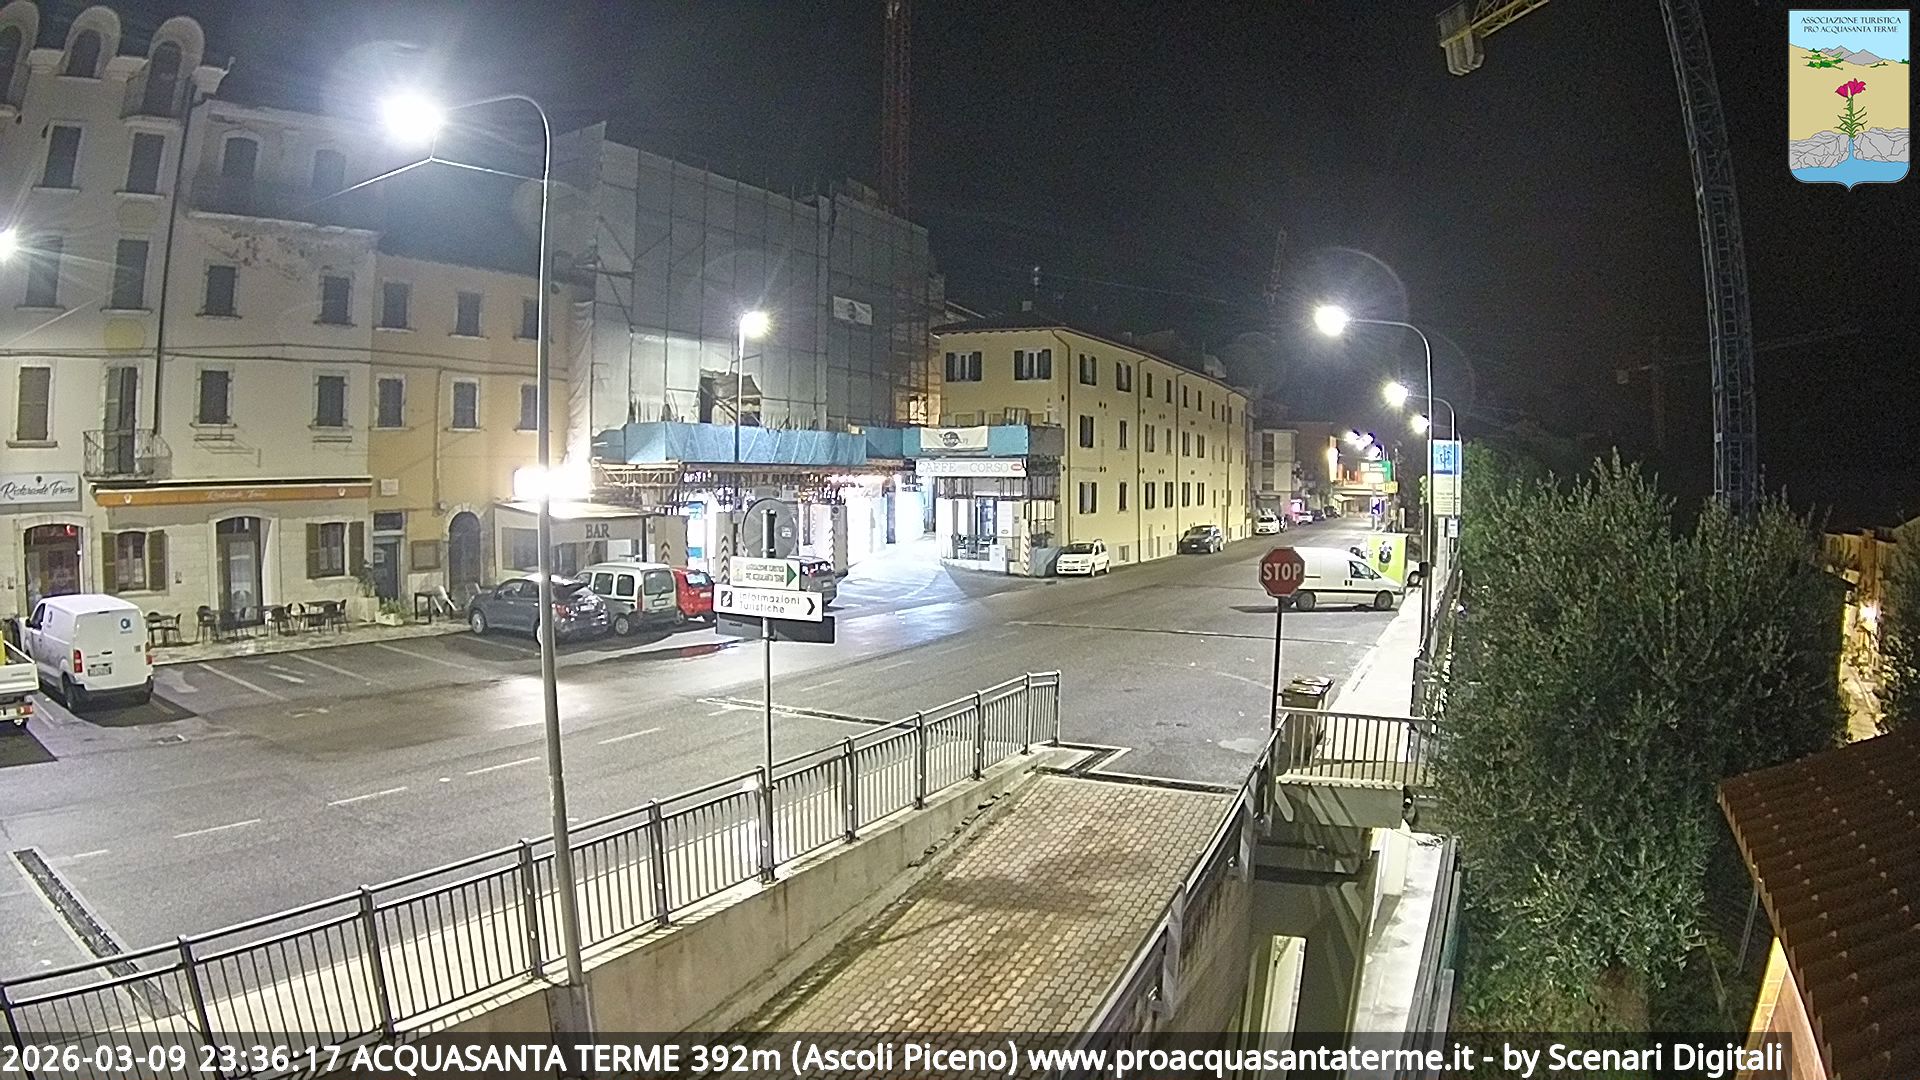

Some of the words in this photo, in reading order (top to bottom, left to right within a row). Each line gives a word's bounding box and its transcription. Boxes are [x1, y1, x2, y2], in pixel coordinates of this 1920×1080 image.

[969, 462, 1009, 472] CORSO
[585, 523, 610, 539] BAR
[1263, 562, 1302, 581] STOP
